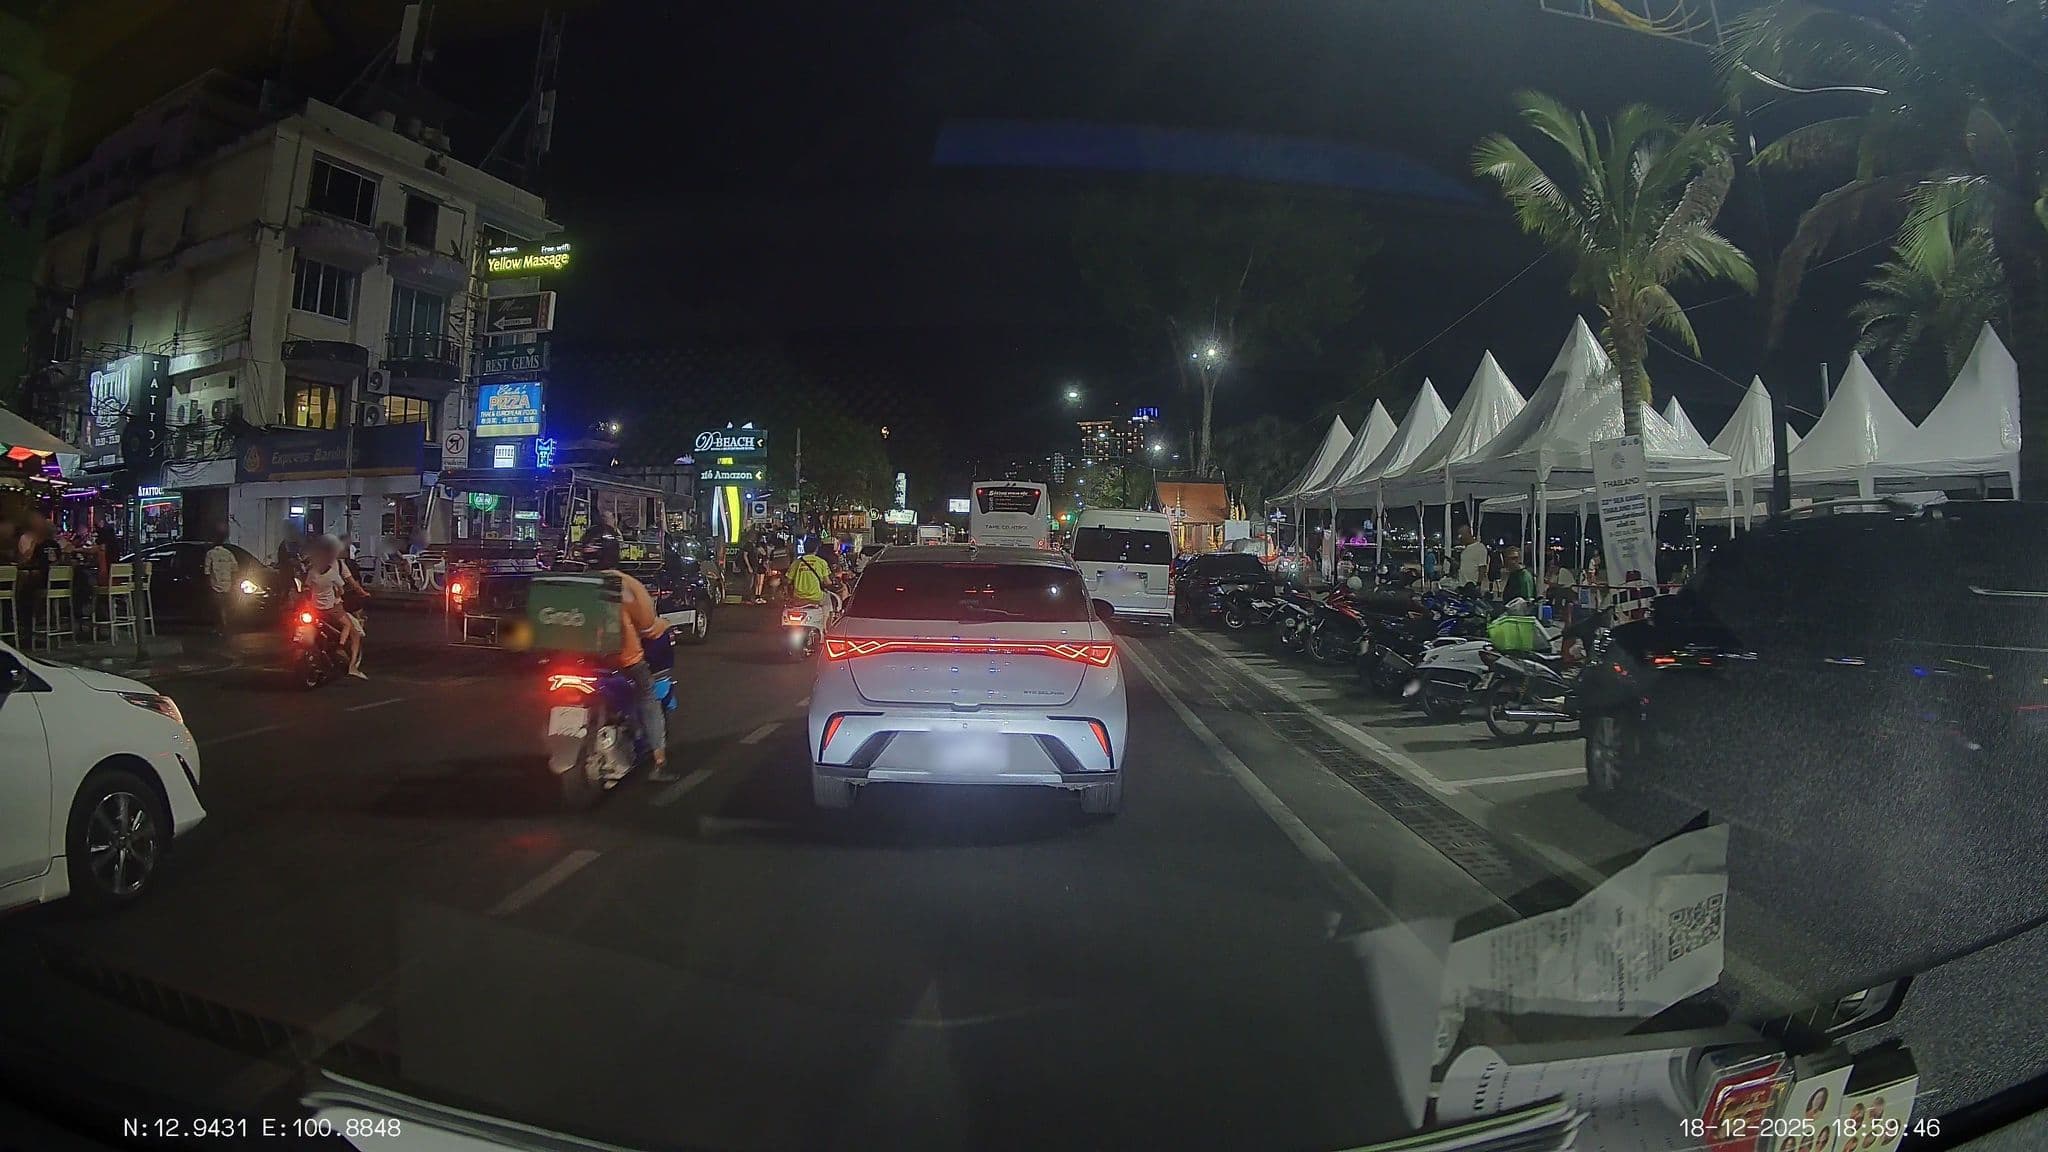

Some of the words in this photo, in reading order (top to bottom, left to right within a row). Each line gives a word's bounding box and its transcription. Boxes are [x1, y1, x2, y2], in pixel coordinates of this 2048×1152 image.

[488, 256, 521, 271] Yellow
[523, 253, 569, 270] Massage
[486, 358, 508, 372] BEST
[512, 355, 539, 370] GEMS
[489, 395, 531, 410] PIZZA
[696, 431, 755, 450] D-BEACH
[714, 470, 753, 480] Amazon
